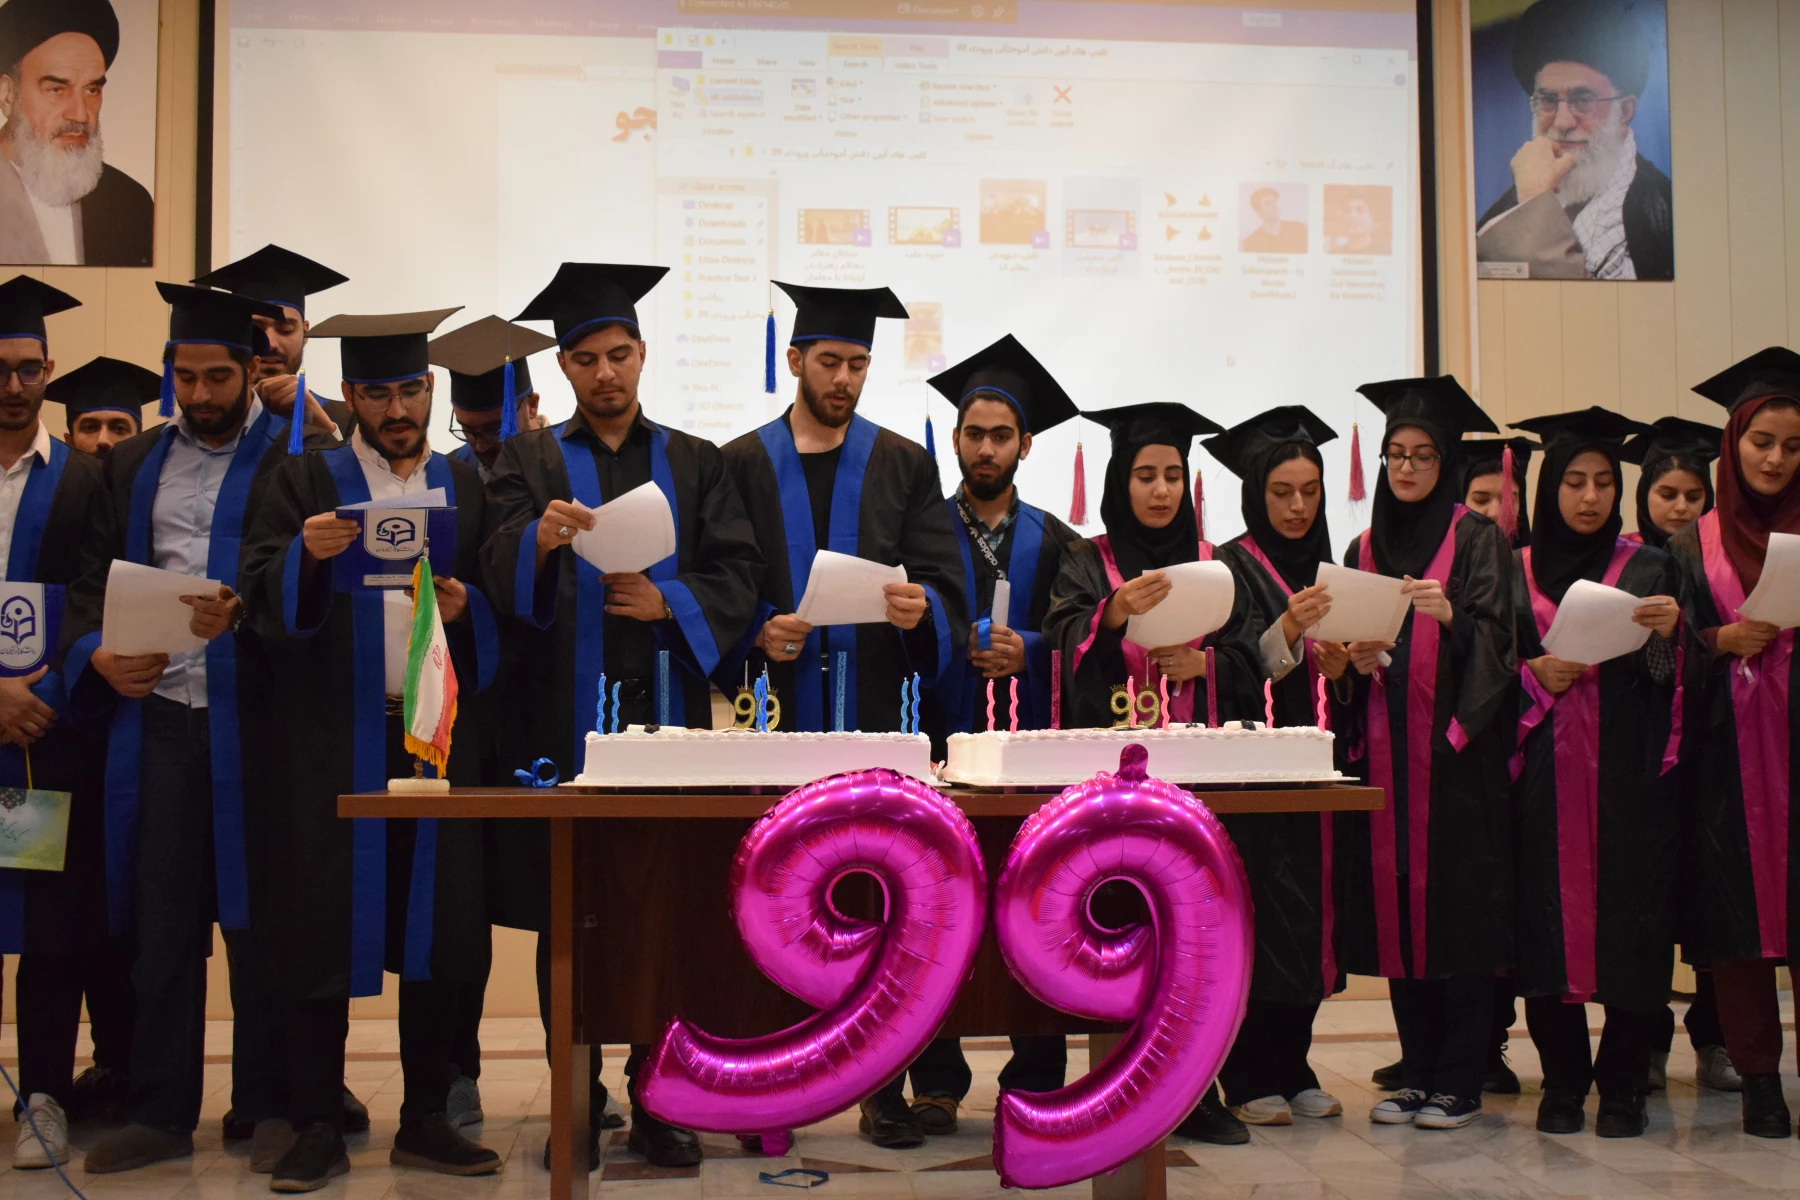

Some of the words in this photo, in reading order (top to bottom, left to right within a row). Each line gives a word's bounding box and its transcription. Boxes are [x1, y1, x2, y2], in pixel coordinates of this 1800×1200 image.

[756, 57, 778, 67] Share
[698, 200, 733, 211] Desktop
[698, 219, 746, 228] Downloads
[698, 237, 746, 246] Documents
[977, 537, 998, 566] adidas
[733, 692, 781, 733] 99
[1110, 690, 1160, 729] 99
[637, 766, 1254, 1189] 99
